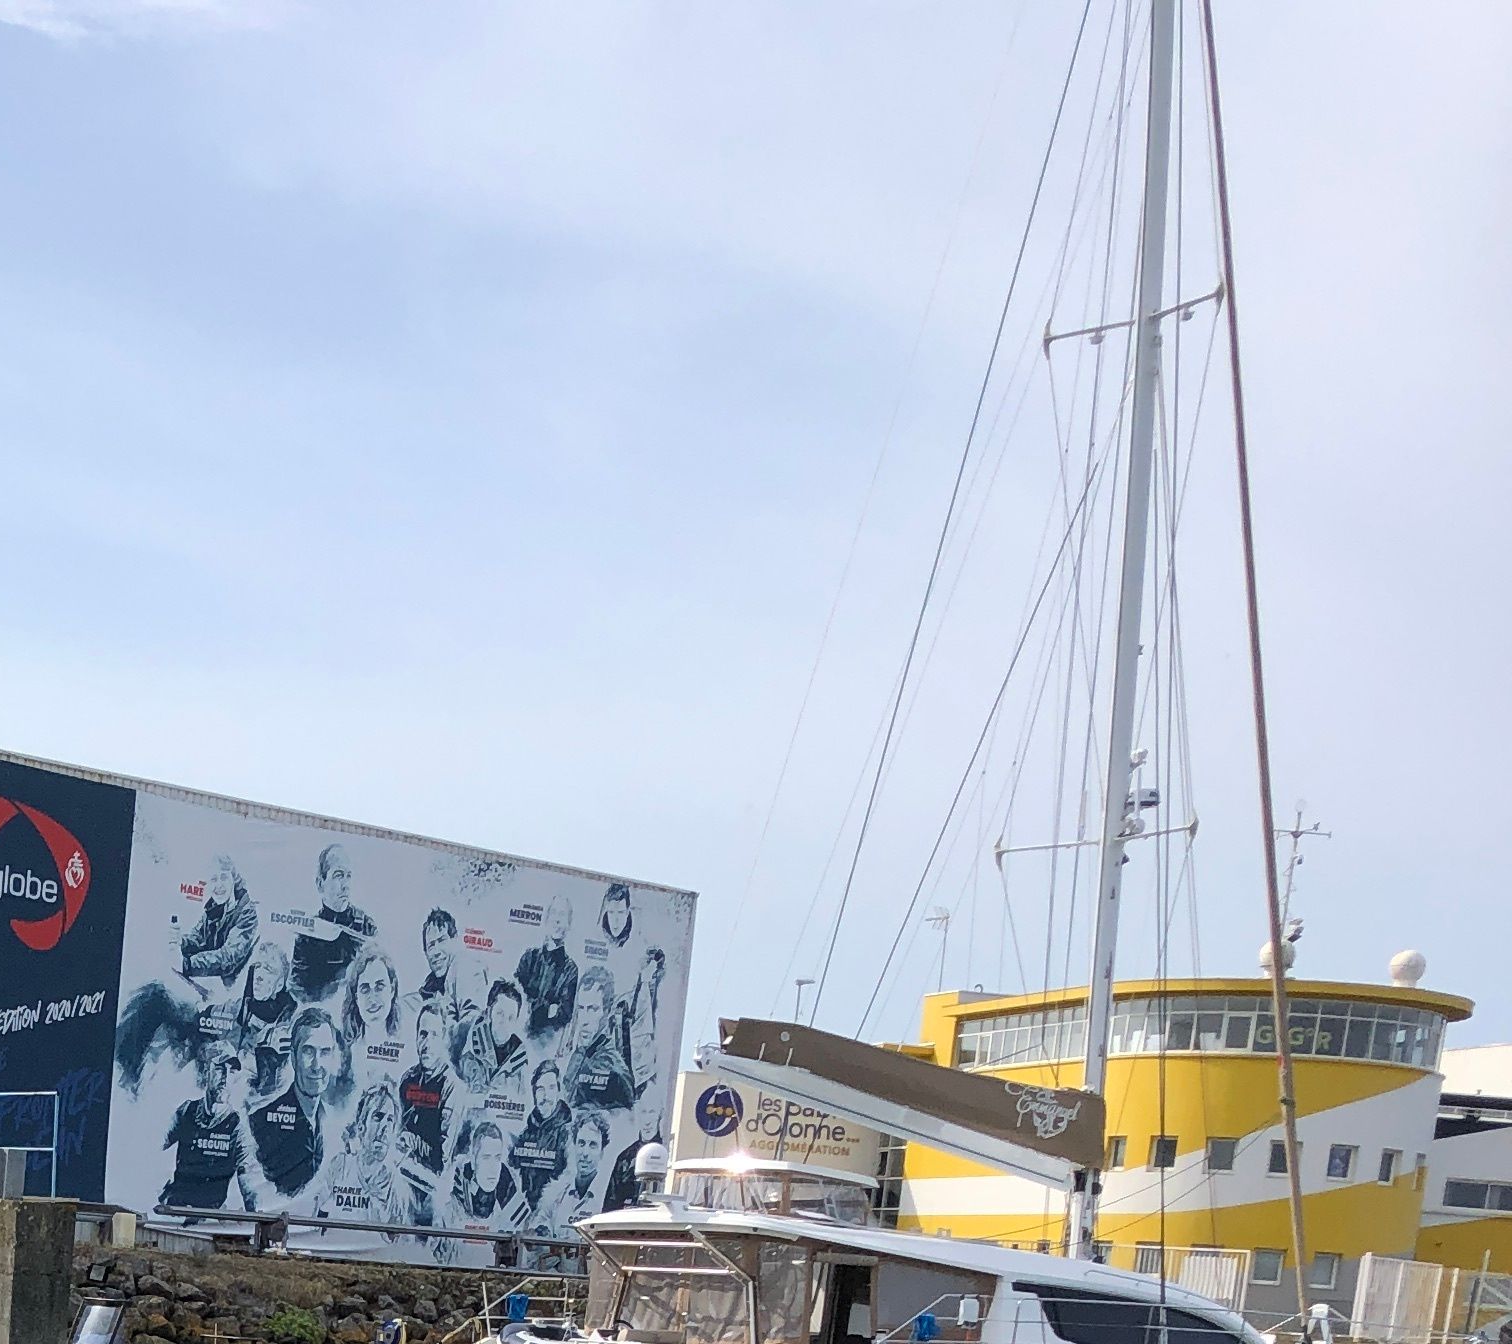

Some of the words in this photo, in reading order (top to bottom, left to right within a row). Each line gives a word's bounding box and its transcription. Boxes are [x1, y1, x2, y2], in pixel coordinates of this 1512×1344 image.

[757, 1091, 782, 1113] les
[266, 1111, 296, 1124] BEYOU
[332, 1185, 364, 1196] CHARLIE
[335, 1194, 371, 1210] DALIN
